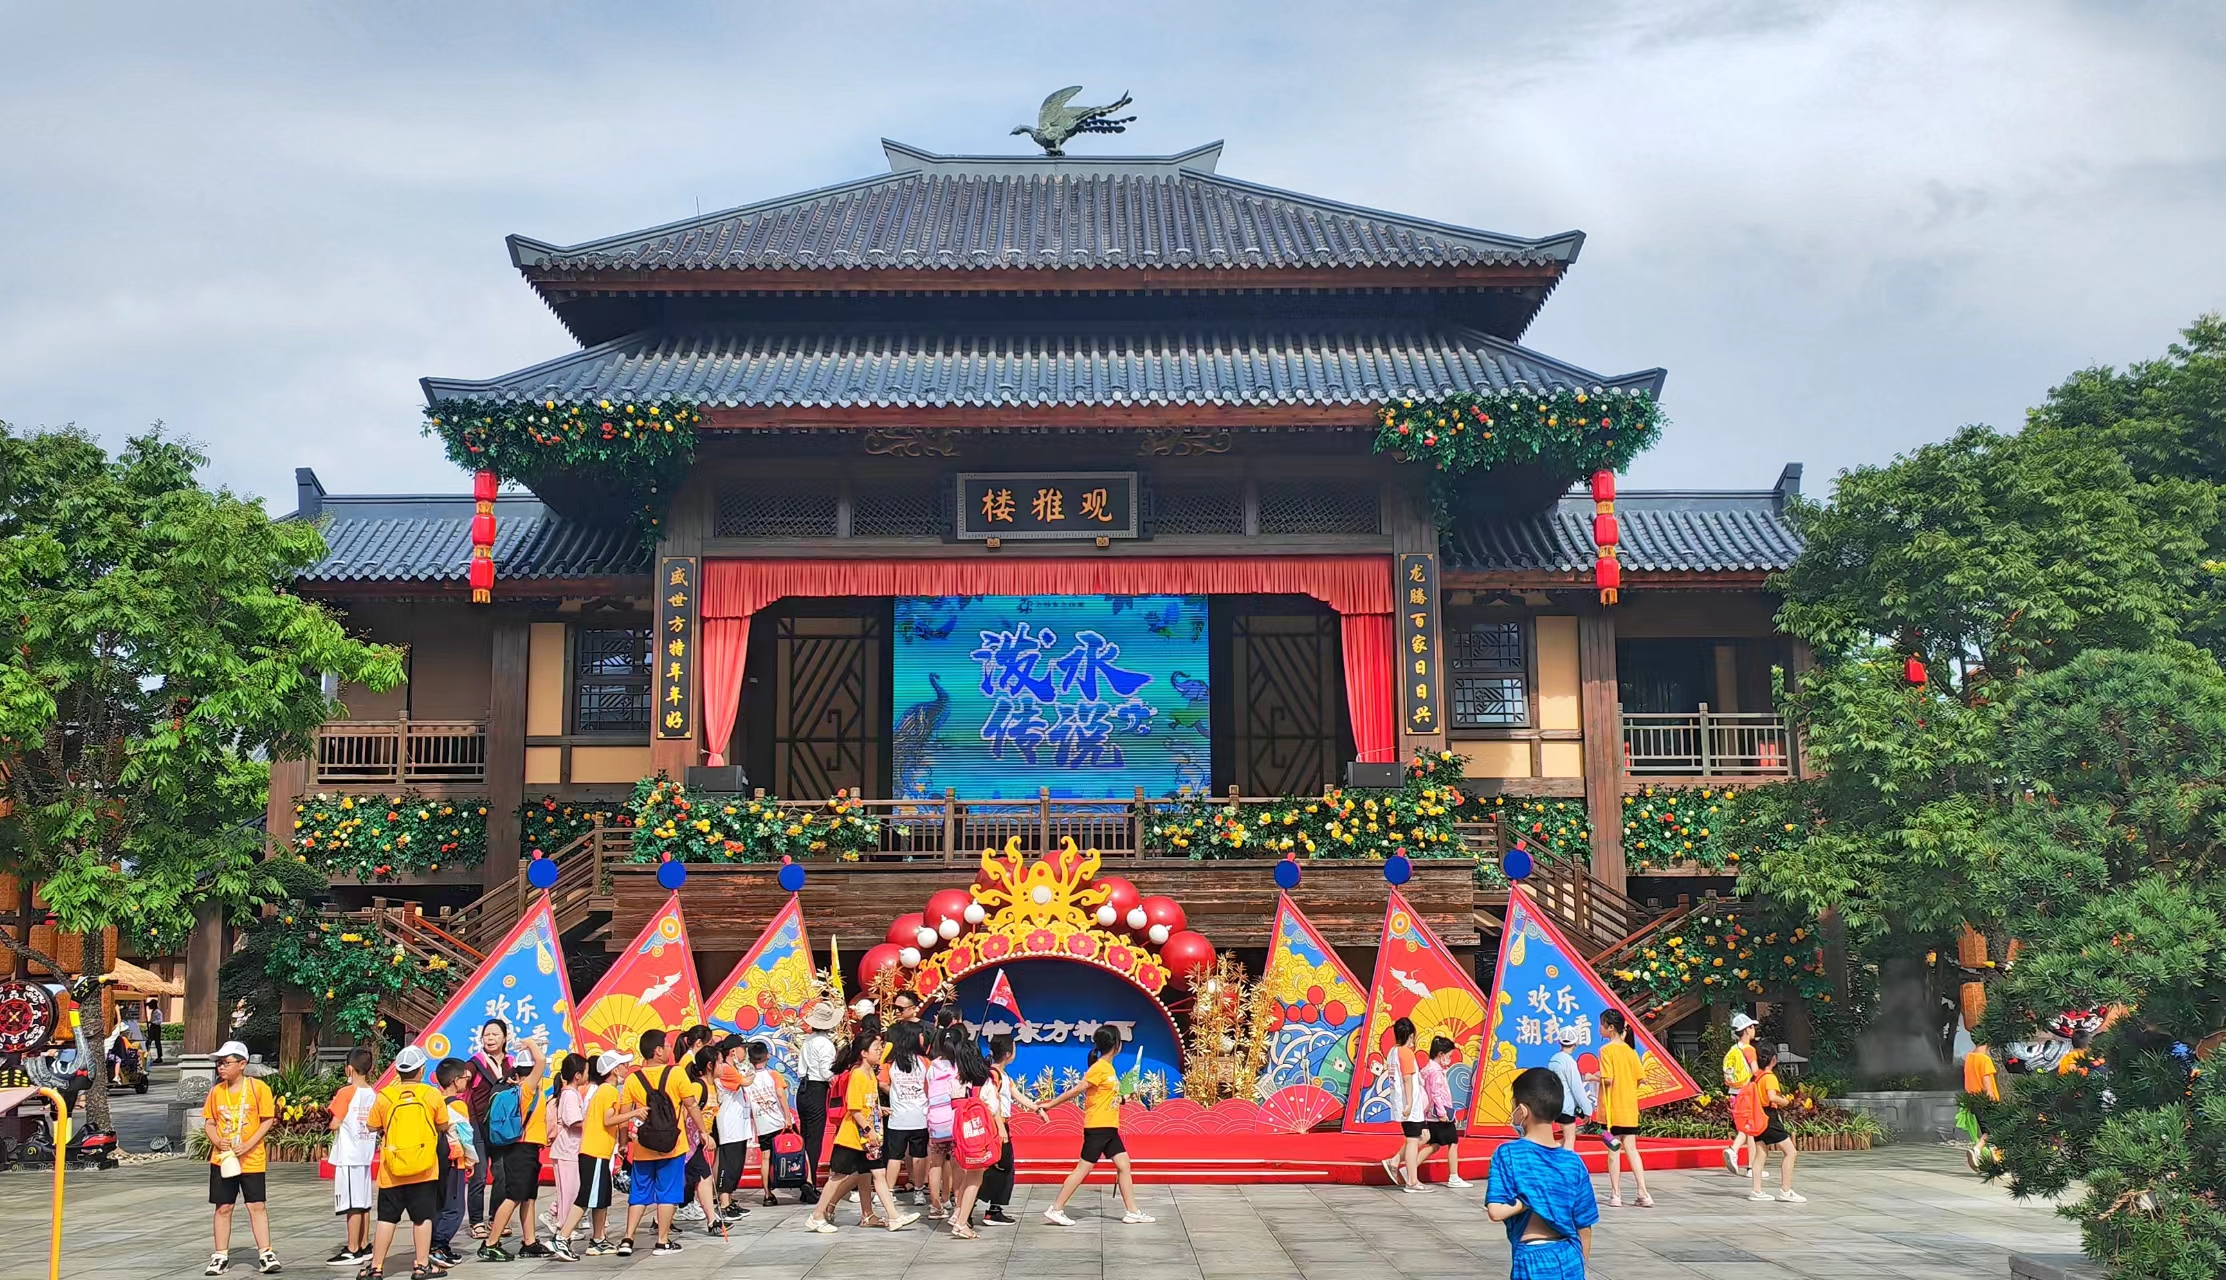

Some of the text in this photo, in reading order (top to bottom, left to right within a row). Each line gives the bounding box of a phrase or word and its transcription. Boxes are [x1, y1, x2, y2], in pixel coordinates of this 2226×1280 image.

[664, 567, 689, 730] 盛世方特年年好
[484, 993, 539, 1024] 欢乐
[1527, 984, 1580, 1015] 欢乐
